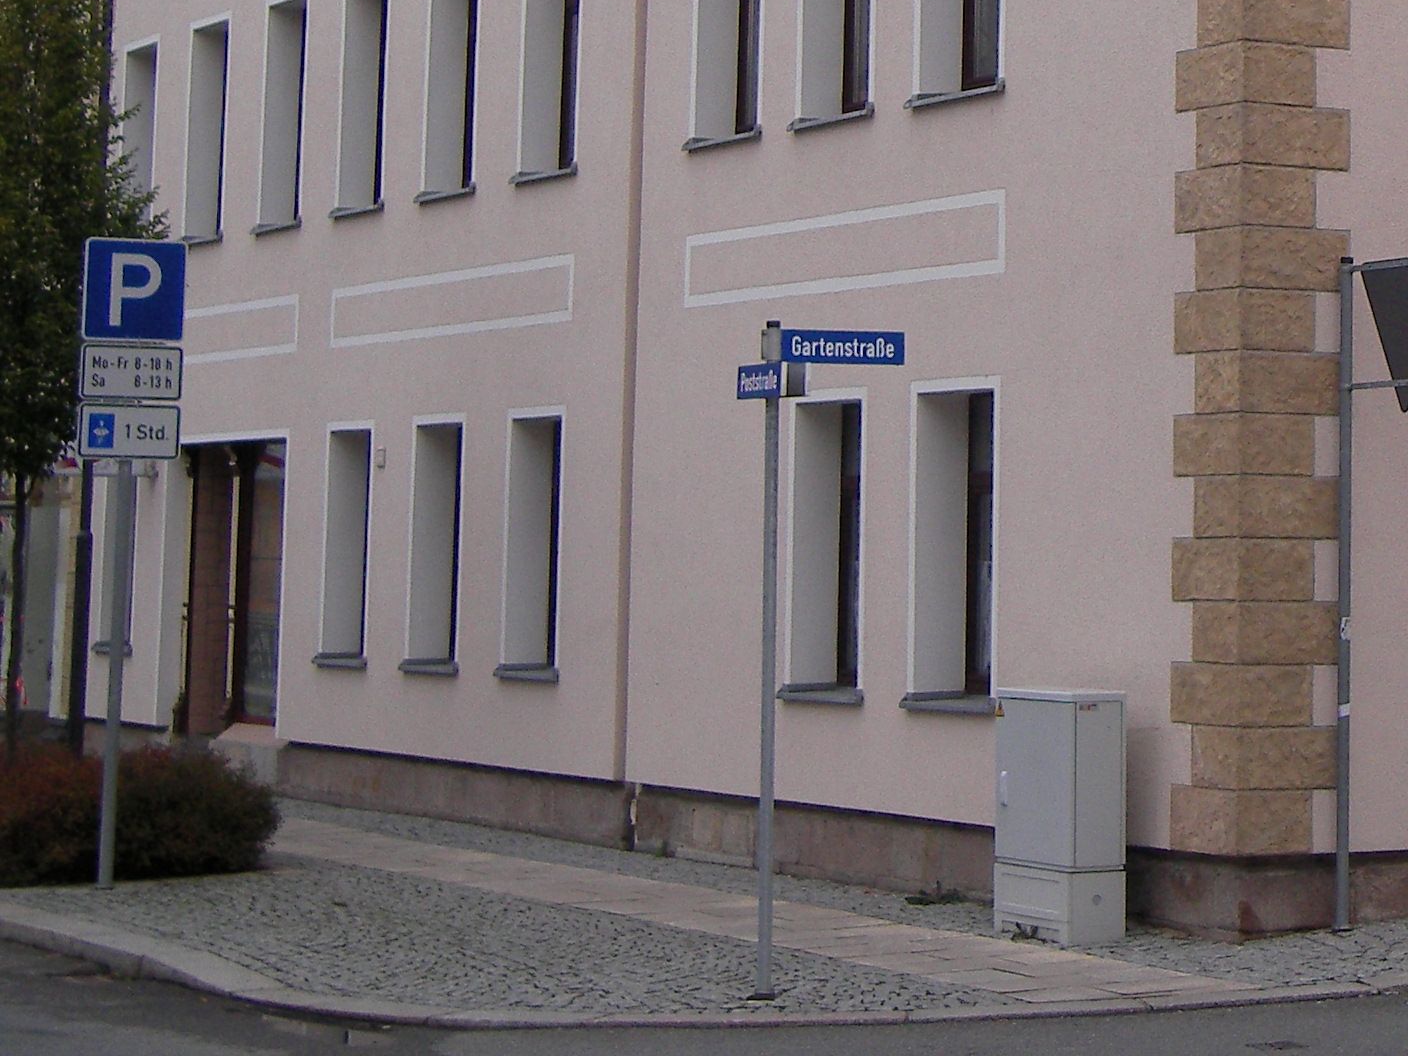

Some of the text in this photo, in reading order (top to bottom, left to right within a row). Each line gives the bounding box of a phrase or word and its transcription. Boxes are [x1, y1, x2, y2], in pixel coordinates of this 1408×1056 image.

[108, 252, 162, 327] P
[791, 335, 895, 358] Gartenstraße
[166, 358, 172, 371] h
[91, 373, 106, 387] Sa
[165, 376, 172, 389] h
[125, 424, 169, 441] 1 Std.
